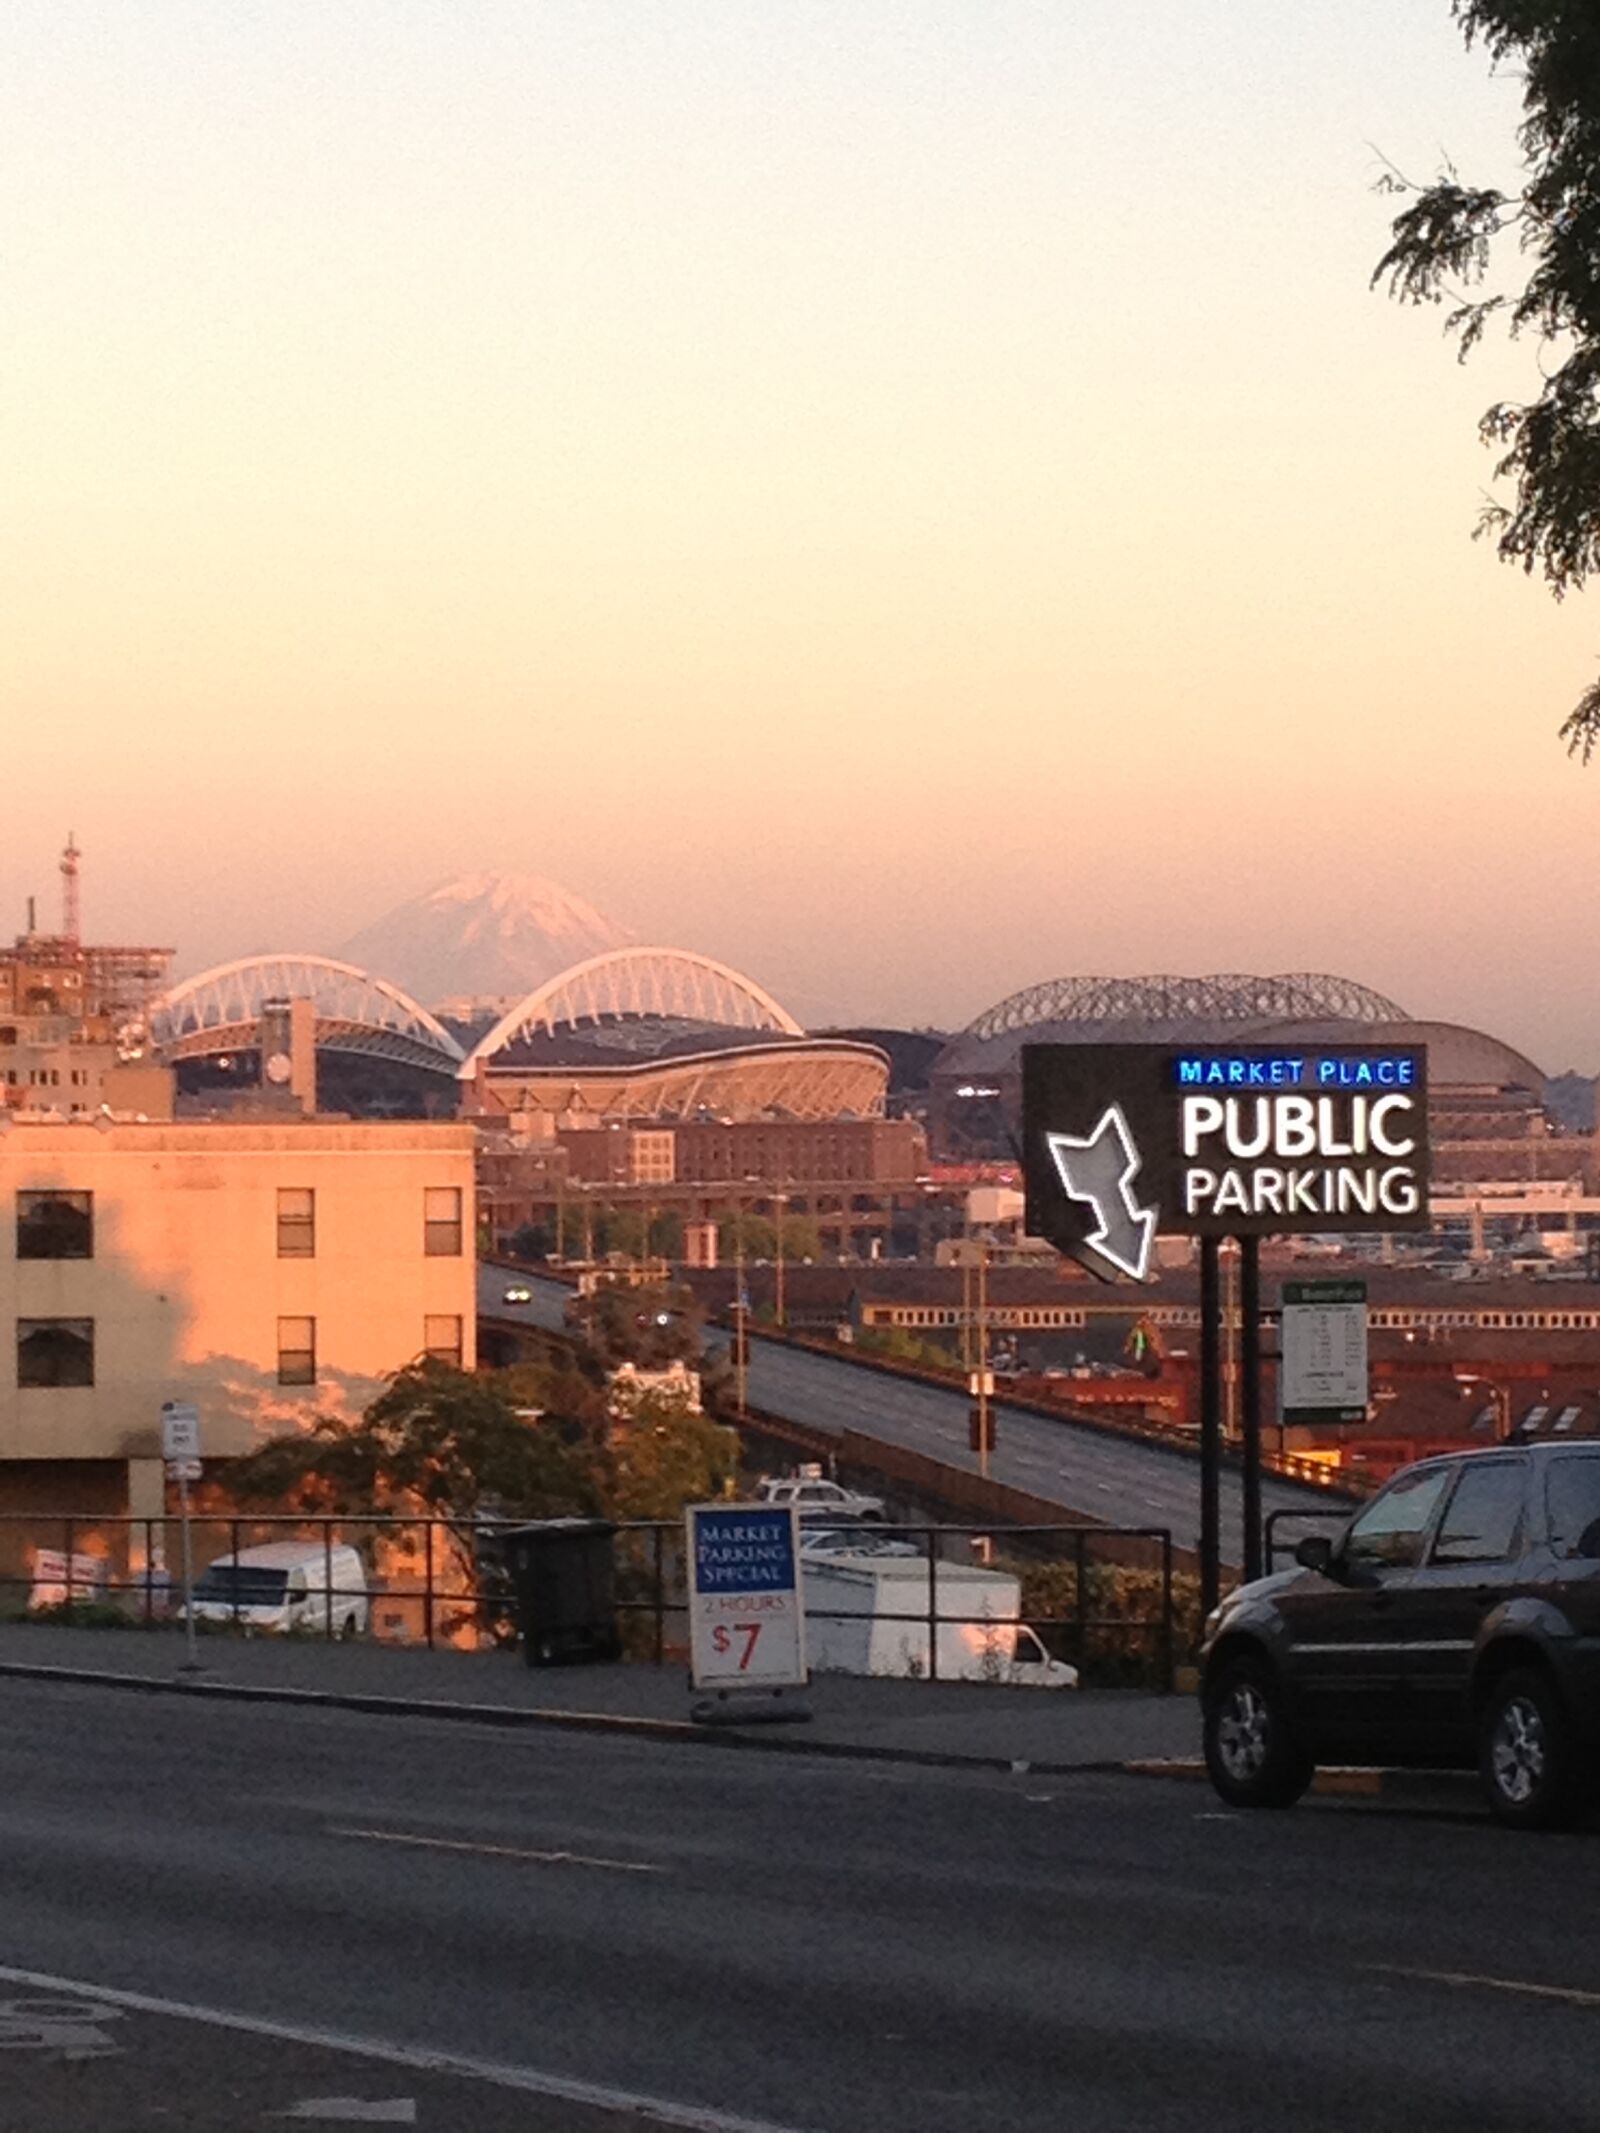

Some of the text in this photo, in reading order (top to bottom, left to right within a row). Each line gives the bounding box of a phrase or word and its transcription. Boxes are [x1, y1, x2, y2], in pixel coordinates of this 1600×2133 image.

[1179, 1060, 1412, 1084] MARKET PLACE
[1183, 1093, 1415, 1158] PUBLIC
[1185, 1167, 1420, 1215] PARKING
[701, 1526, 782, 1542] MARKET
[698, 1544, 786, 1563] PARKING
[703, 1566, 781, 1583] SPECIAL
[705, 1596, 786, 1613] 2 HOURS
[712, 1623, 763, 1670] $7
